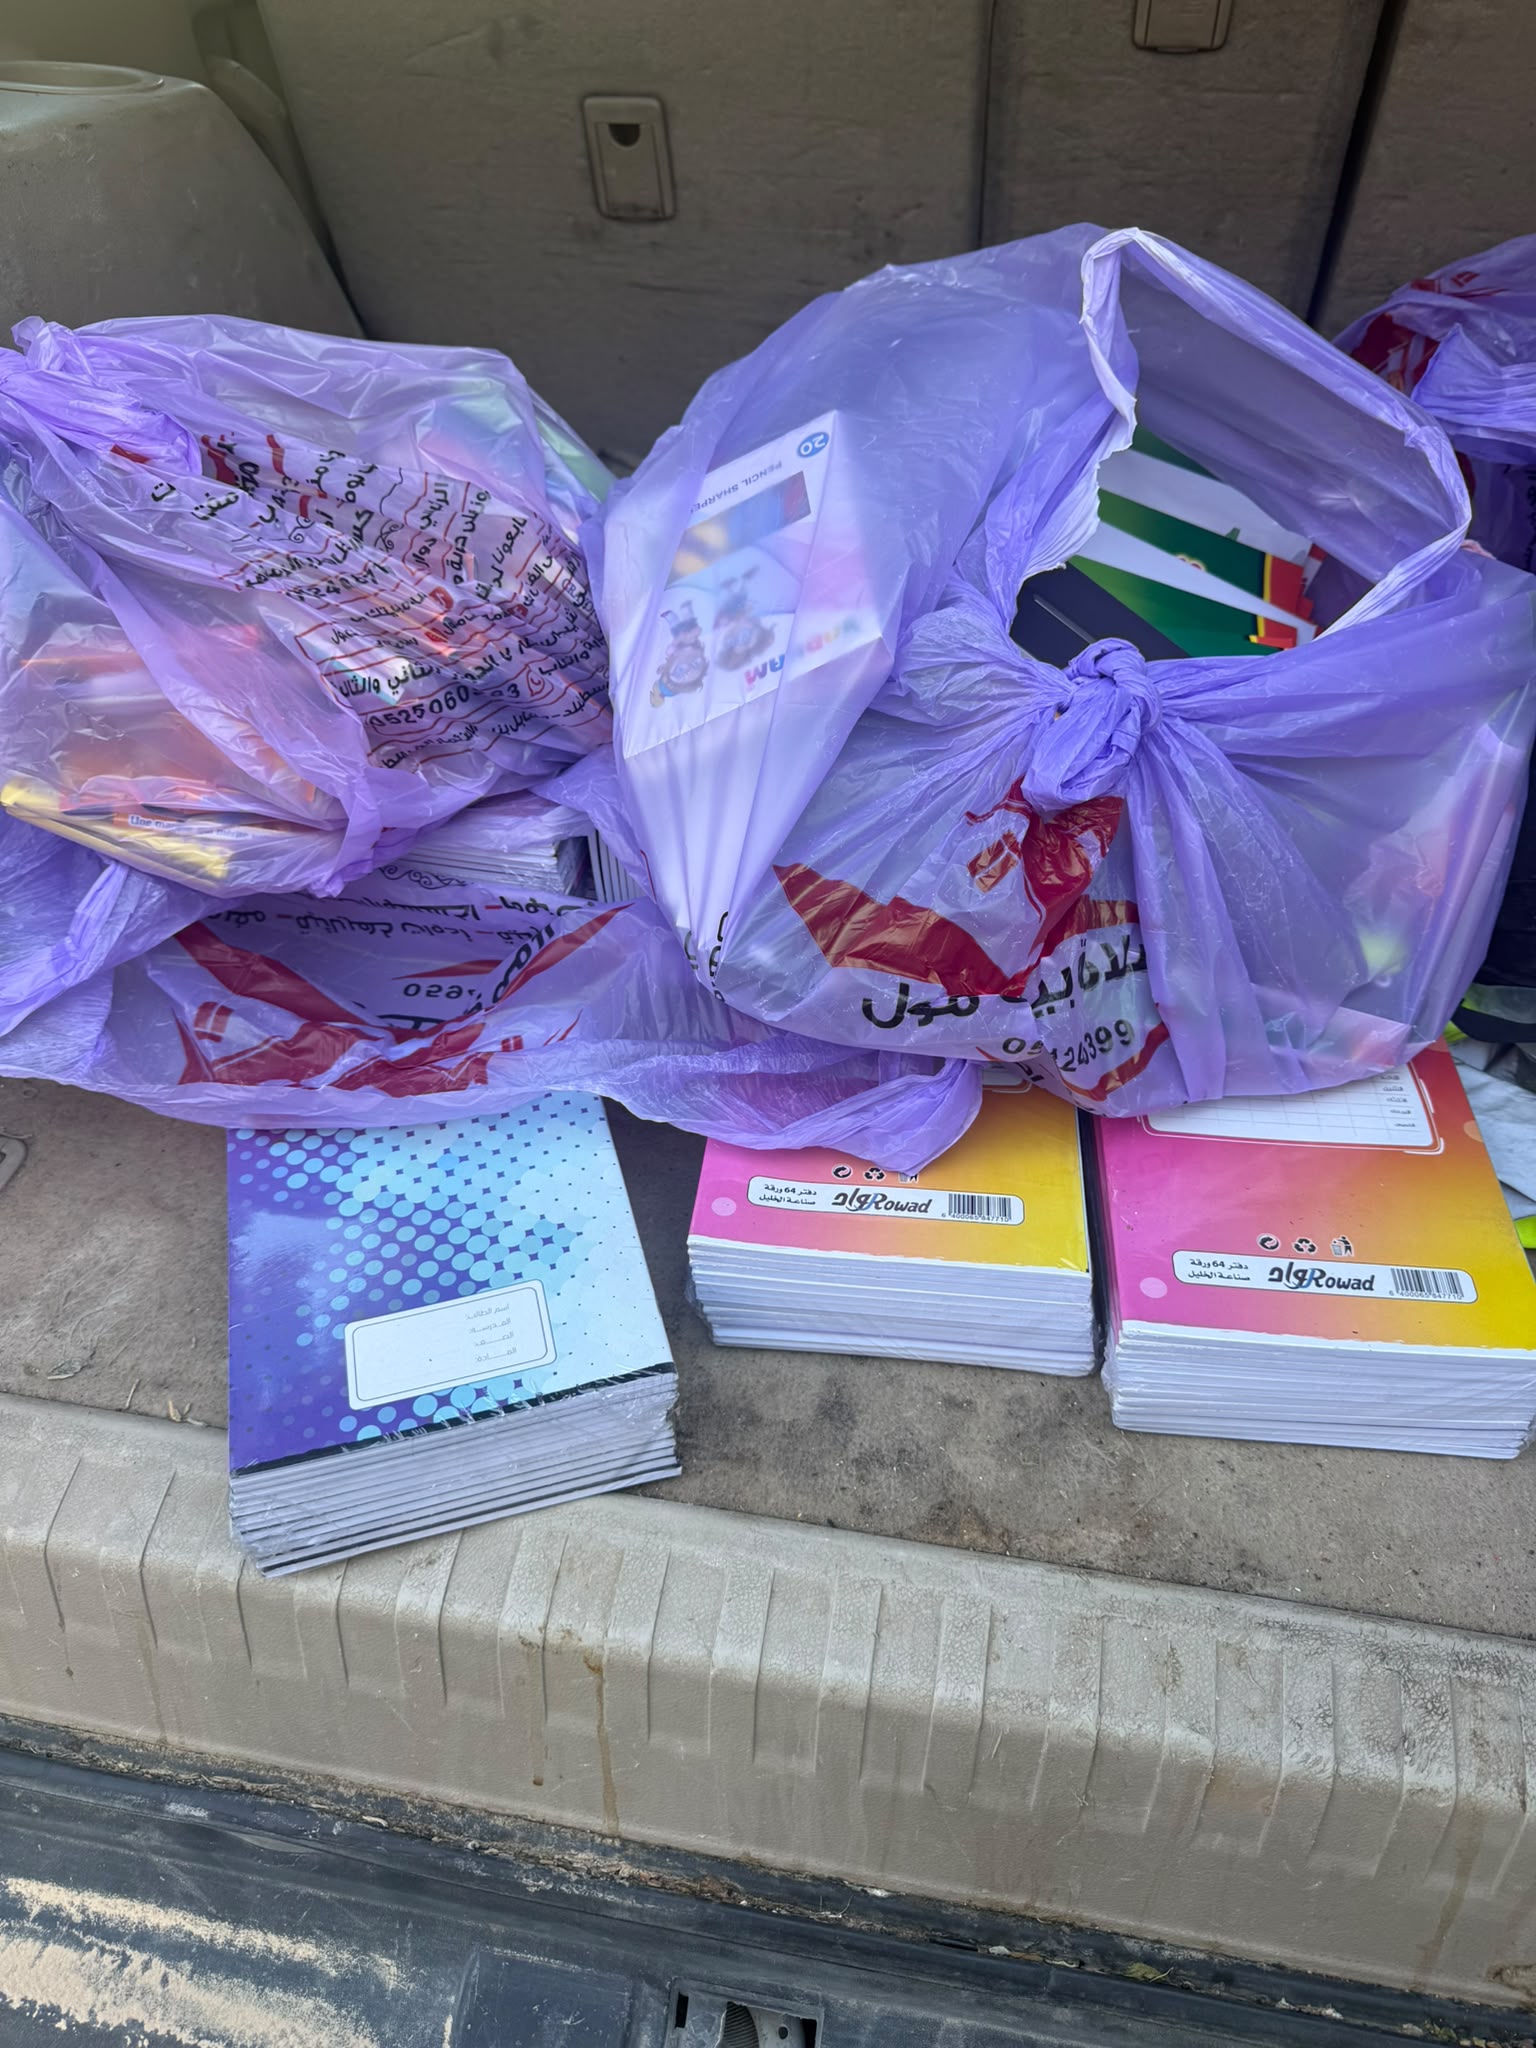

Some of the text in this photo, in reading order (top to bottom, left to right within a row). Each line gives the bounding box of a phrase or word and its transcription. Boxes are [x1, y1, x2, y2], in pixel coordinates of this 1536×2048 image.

[800, 434, 826, 456] 20
[741, 461, 783, 488] PENCIL
[764, 1183, 817, 1197] دفتر 64 ورقة
[759, 1193, 816, 1206] صناعة الخليل
[1189, 1258, 1249, 1271] دفتر 64 ورقة
[1188, 1270, 1251, 1281] صناعة الخليل
